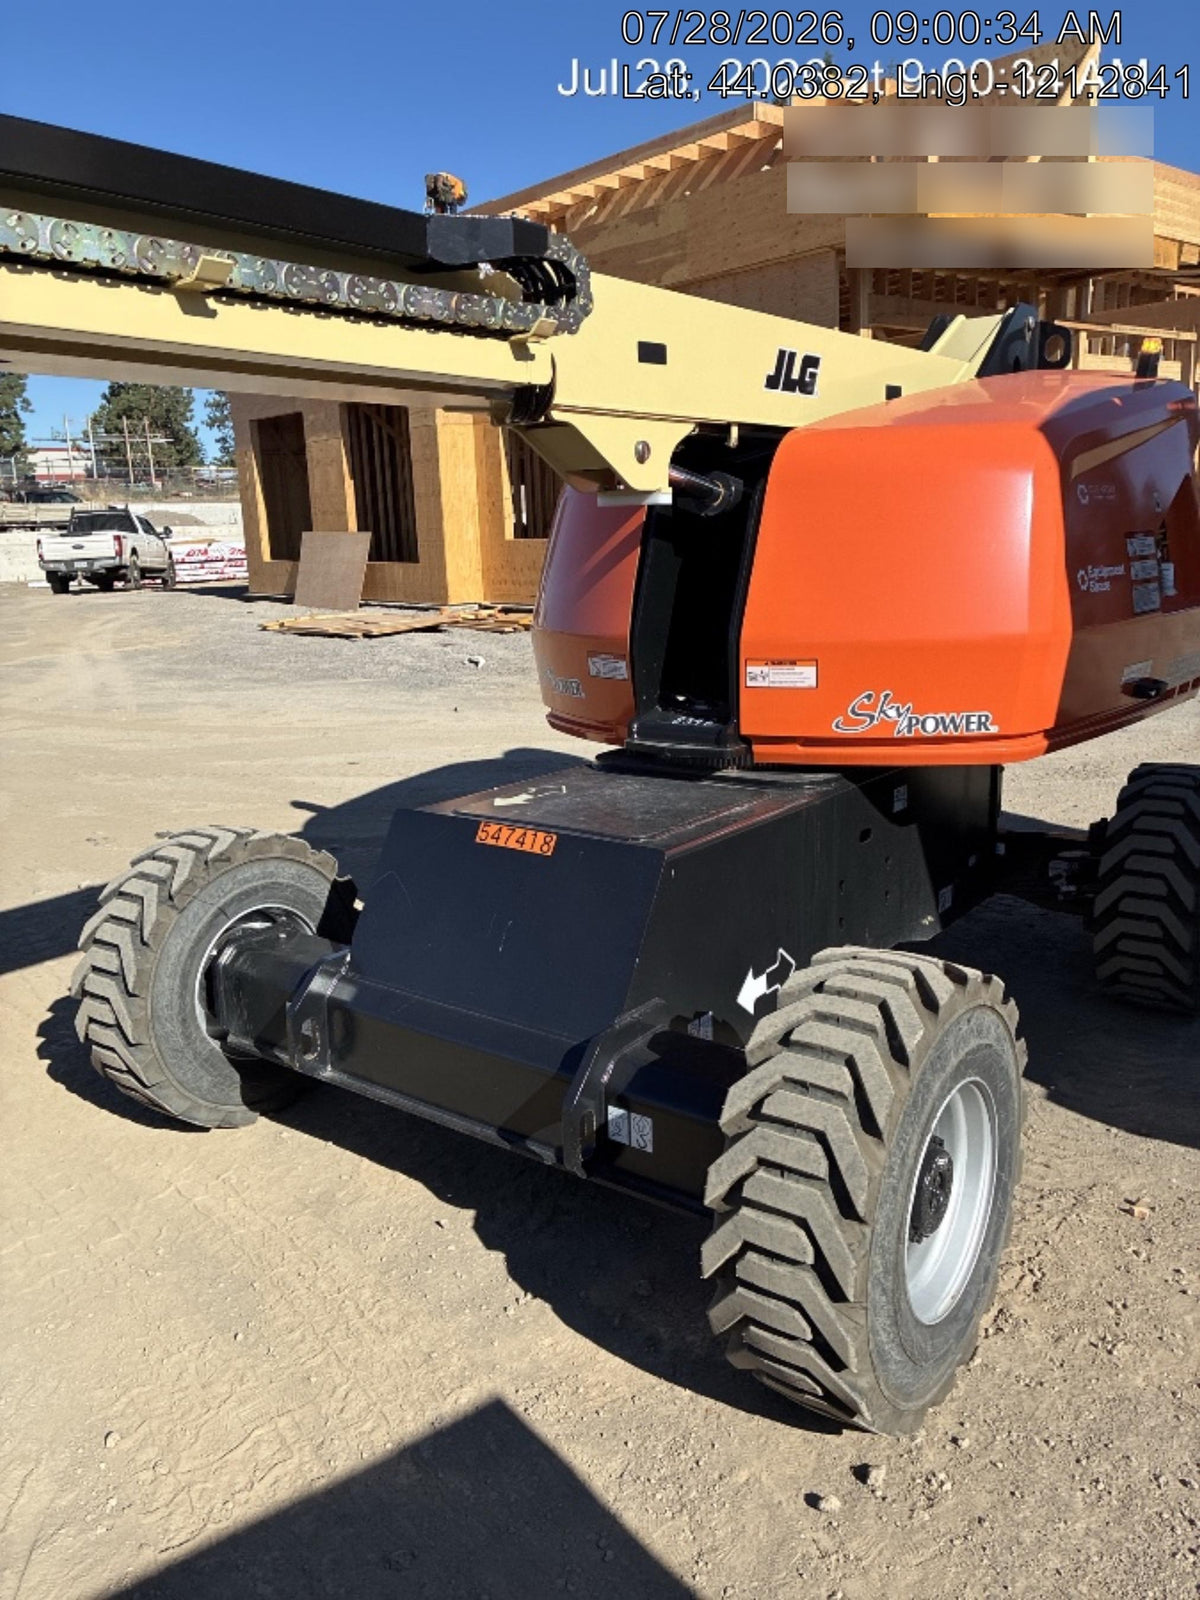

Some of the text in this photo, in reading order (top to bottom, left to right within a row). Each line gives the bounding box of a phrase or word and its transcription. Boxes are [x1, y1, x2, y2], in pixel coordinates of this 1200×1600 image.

[764, 347, 821, 396] JLG
[832, 691, 991, 737] Sky POWER
[478, 822, 554, 854] 547418
